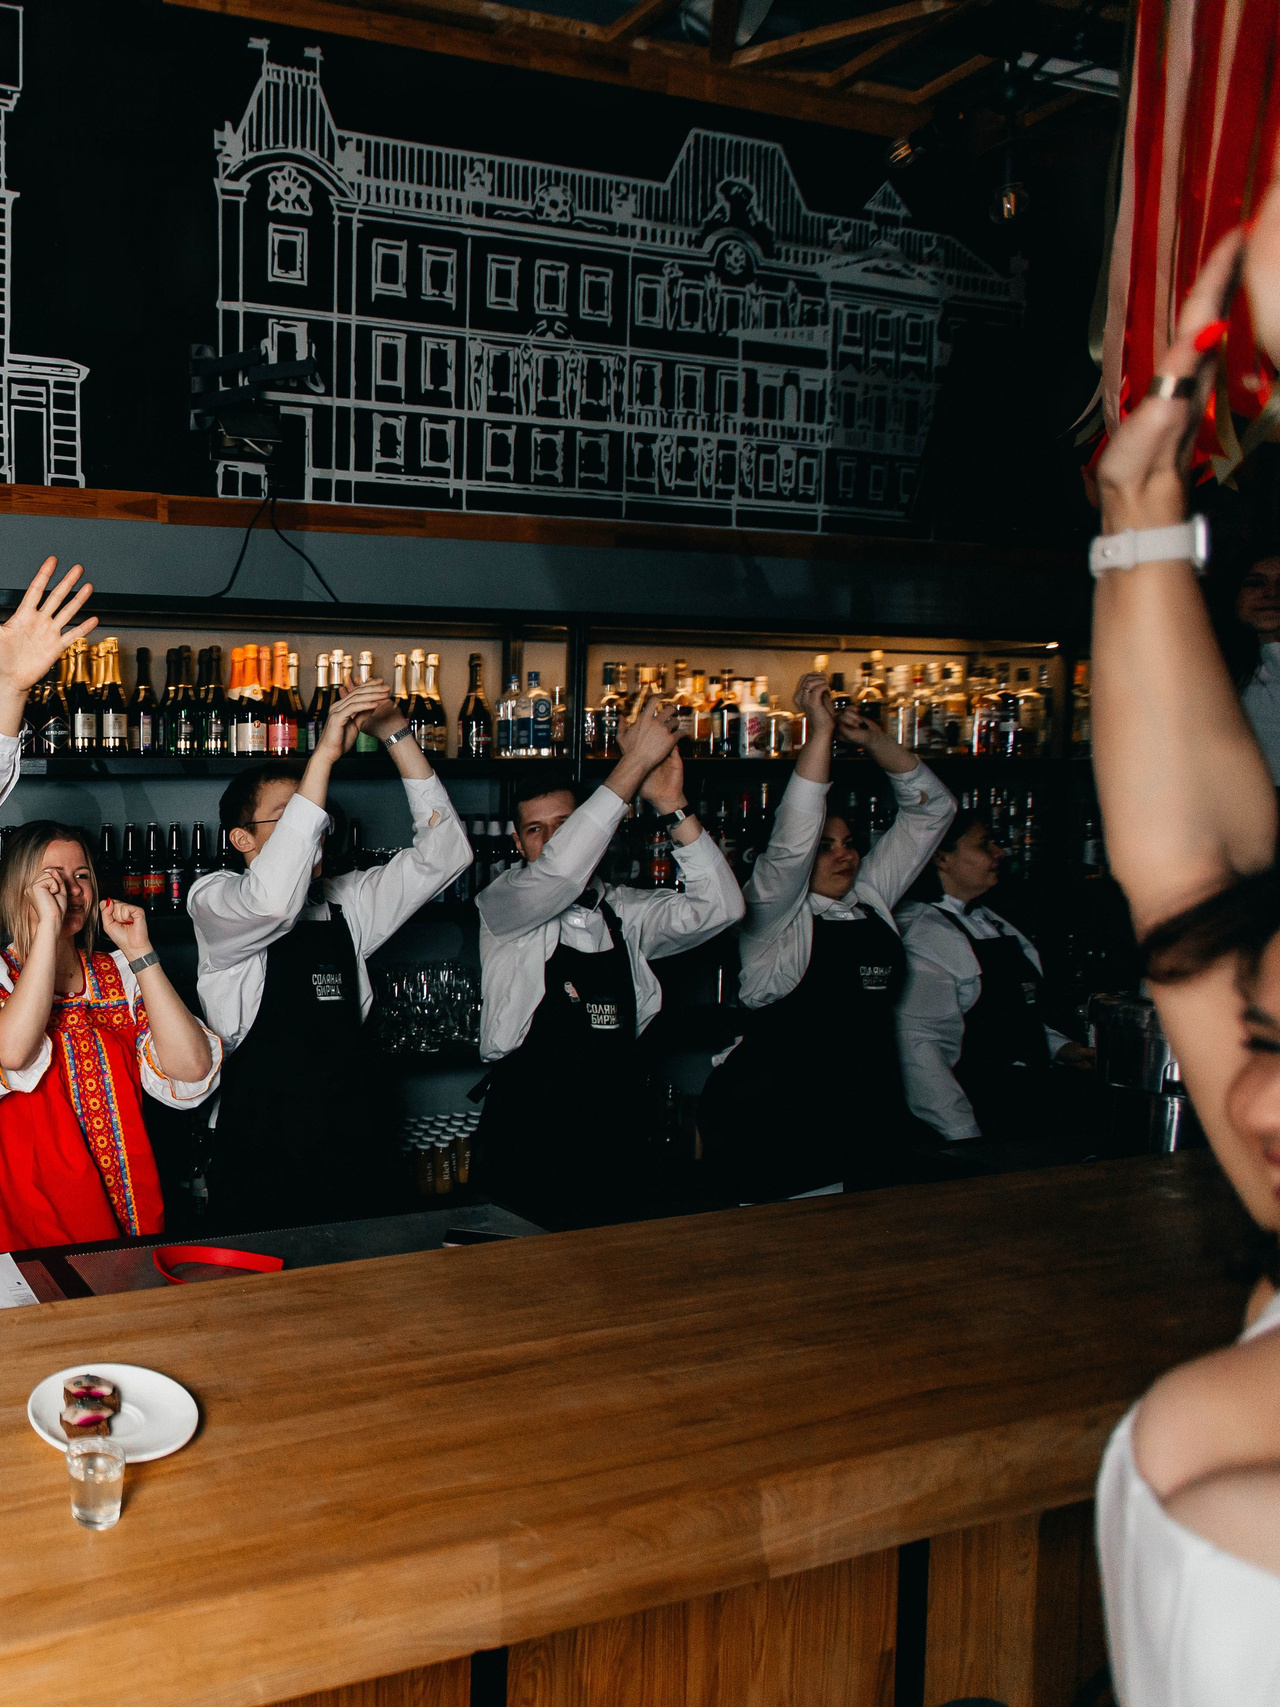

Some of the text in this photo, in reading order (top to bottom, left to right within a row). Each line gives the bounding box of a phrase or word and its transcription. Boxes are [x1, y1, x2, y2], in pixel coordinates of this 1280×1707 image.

[312, 973, 342, 985] СОЛЯНАЯ
[316, 985, 341, 996] БИРЖА
[586, 1003, 617, 1014] СОЛЯН
[591, 1014, 617, 1024] БИРЖ
